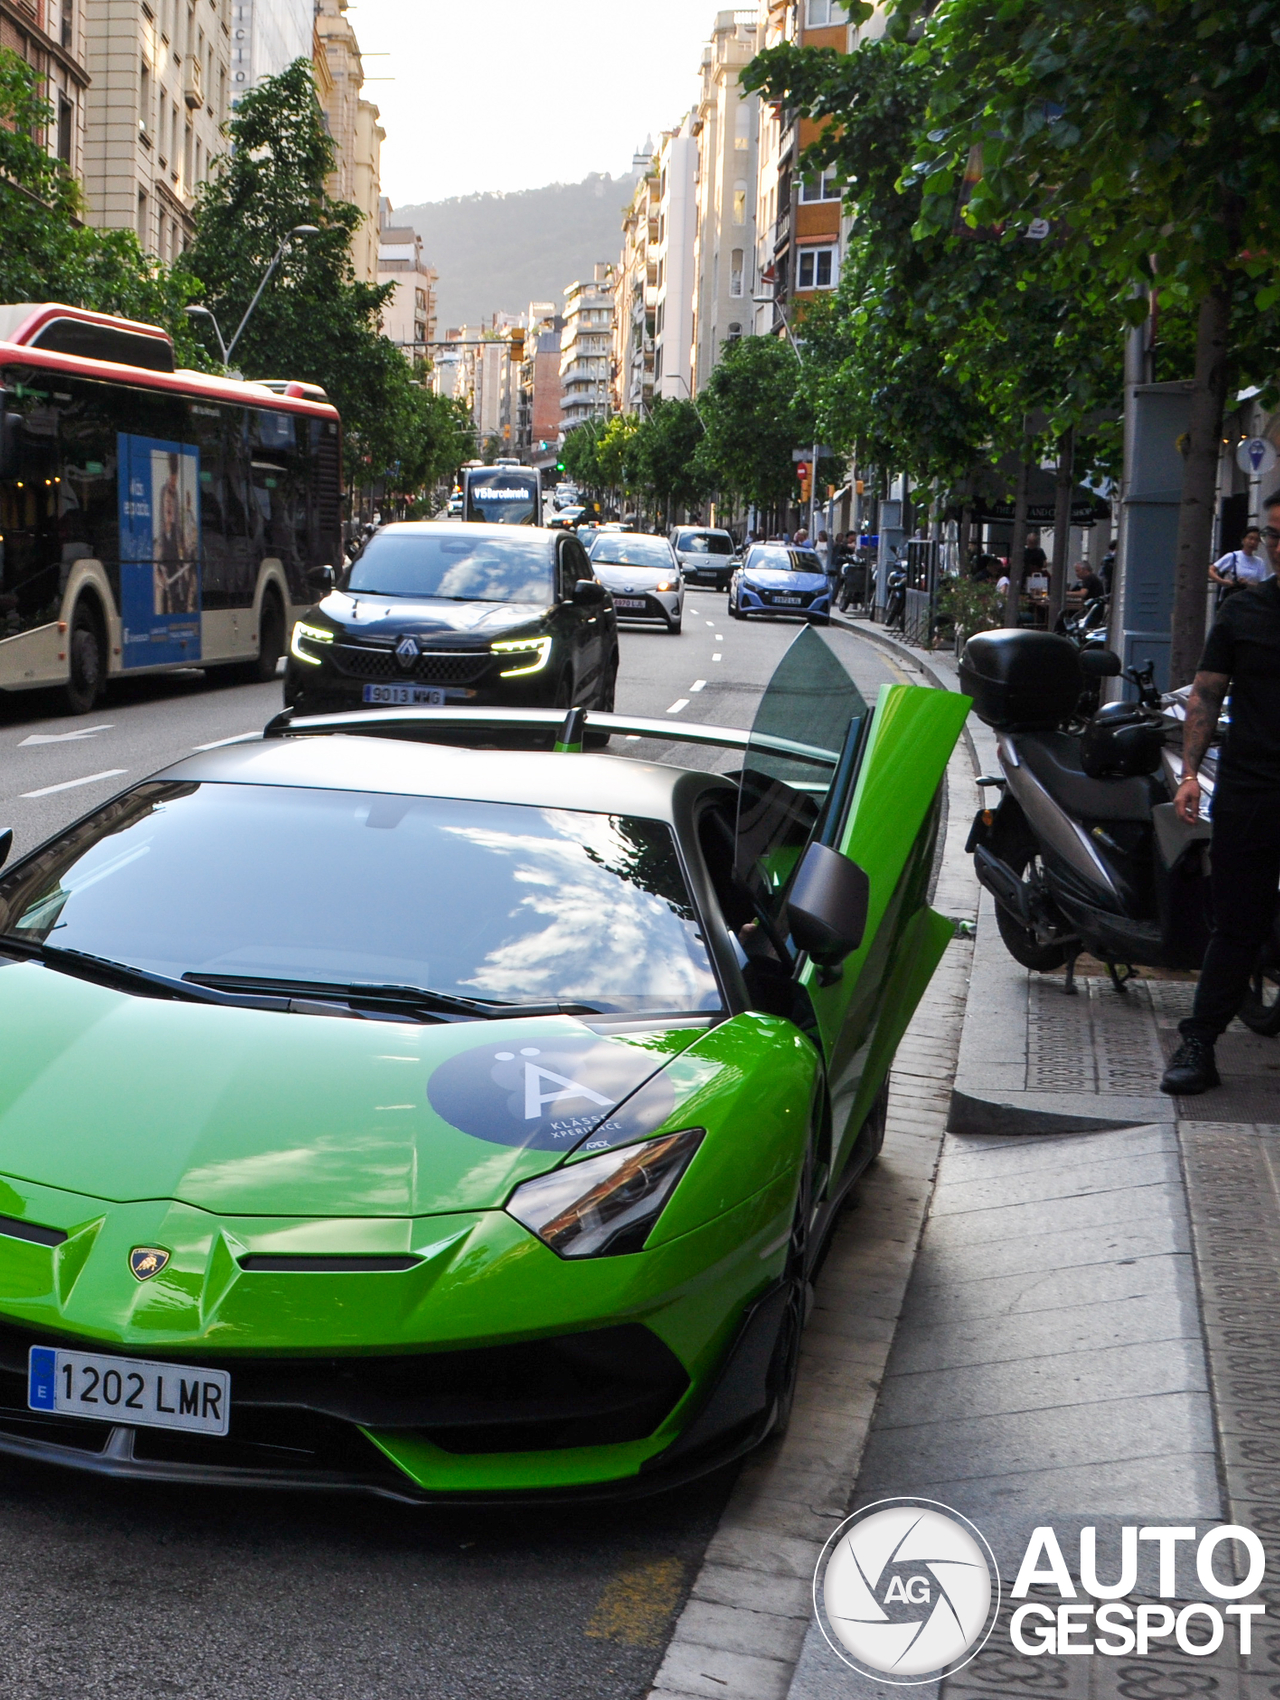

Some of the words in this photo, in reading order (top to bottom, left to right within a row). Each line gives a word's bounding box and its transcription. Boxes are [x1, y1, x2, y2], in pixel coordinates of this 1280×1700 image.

[1031, 508, 1048, 516] AND
[373, 687, 409, 702] 9013
[37, 1385, 47, 1398] E
[62, 1363, 145, 1409] 1202
[156, 1375, 222, 1420] LMR
